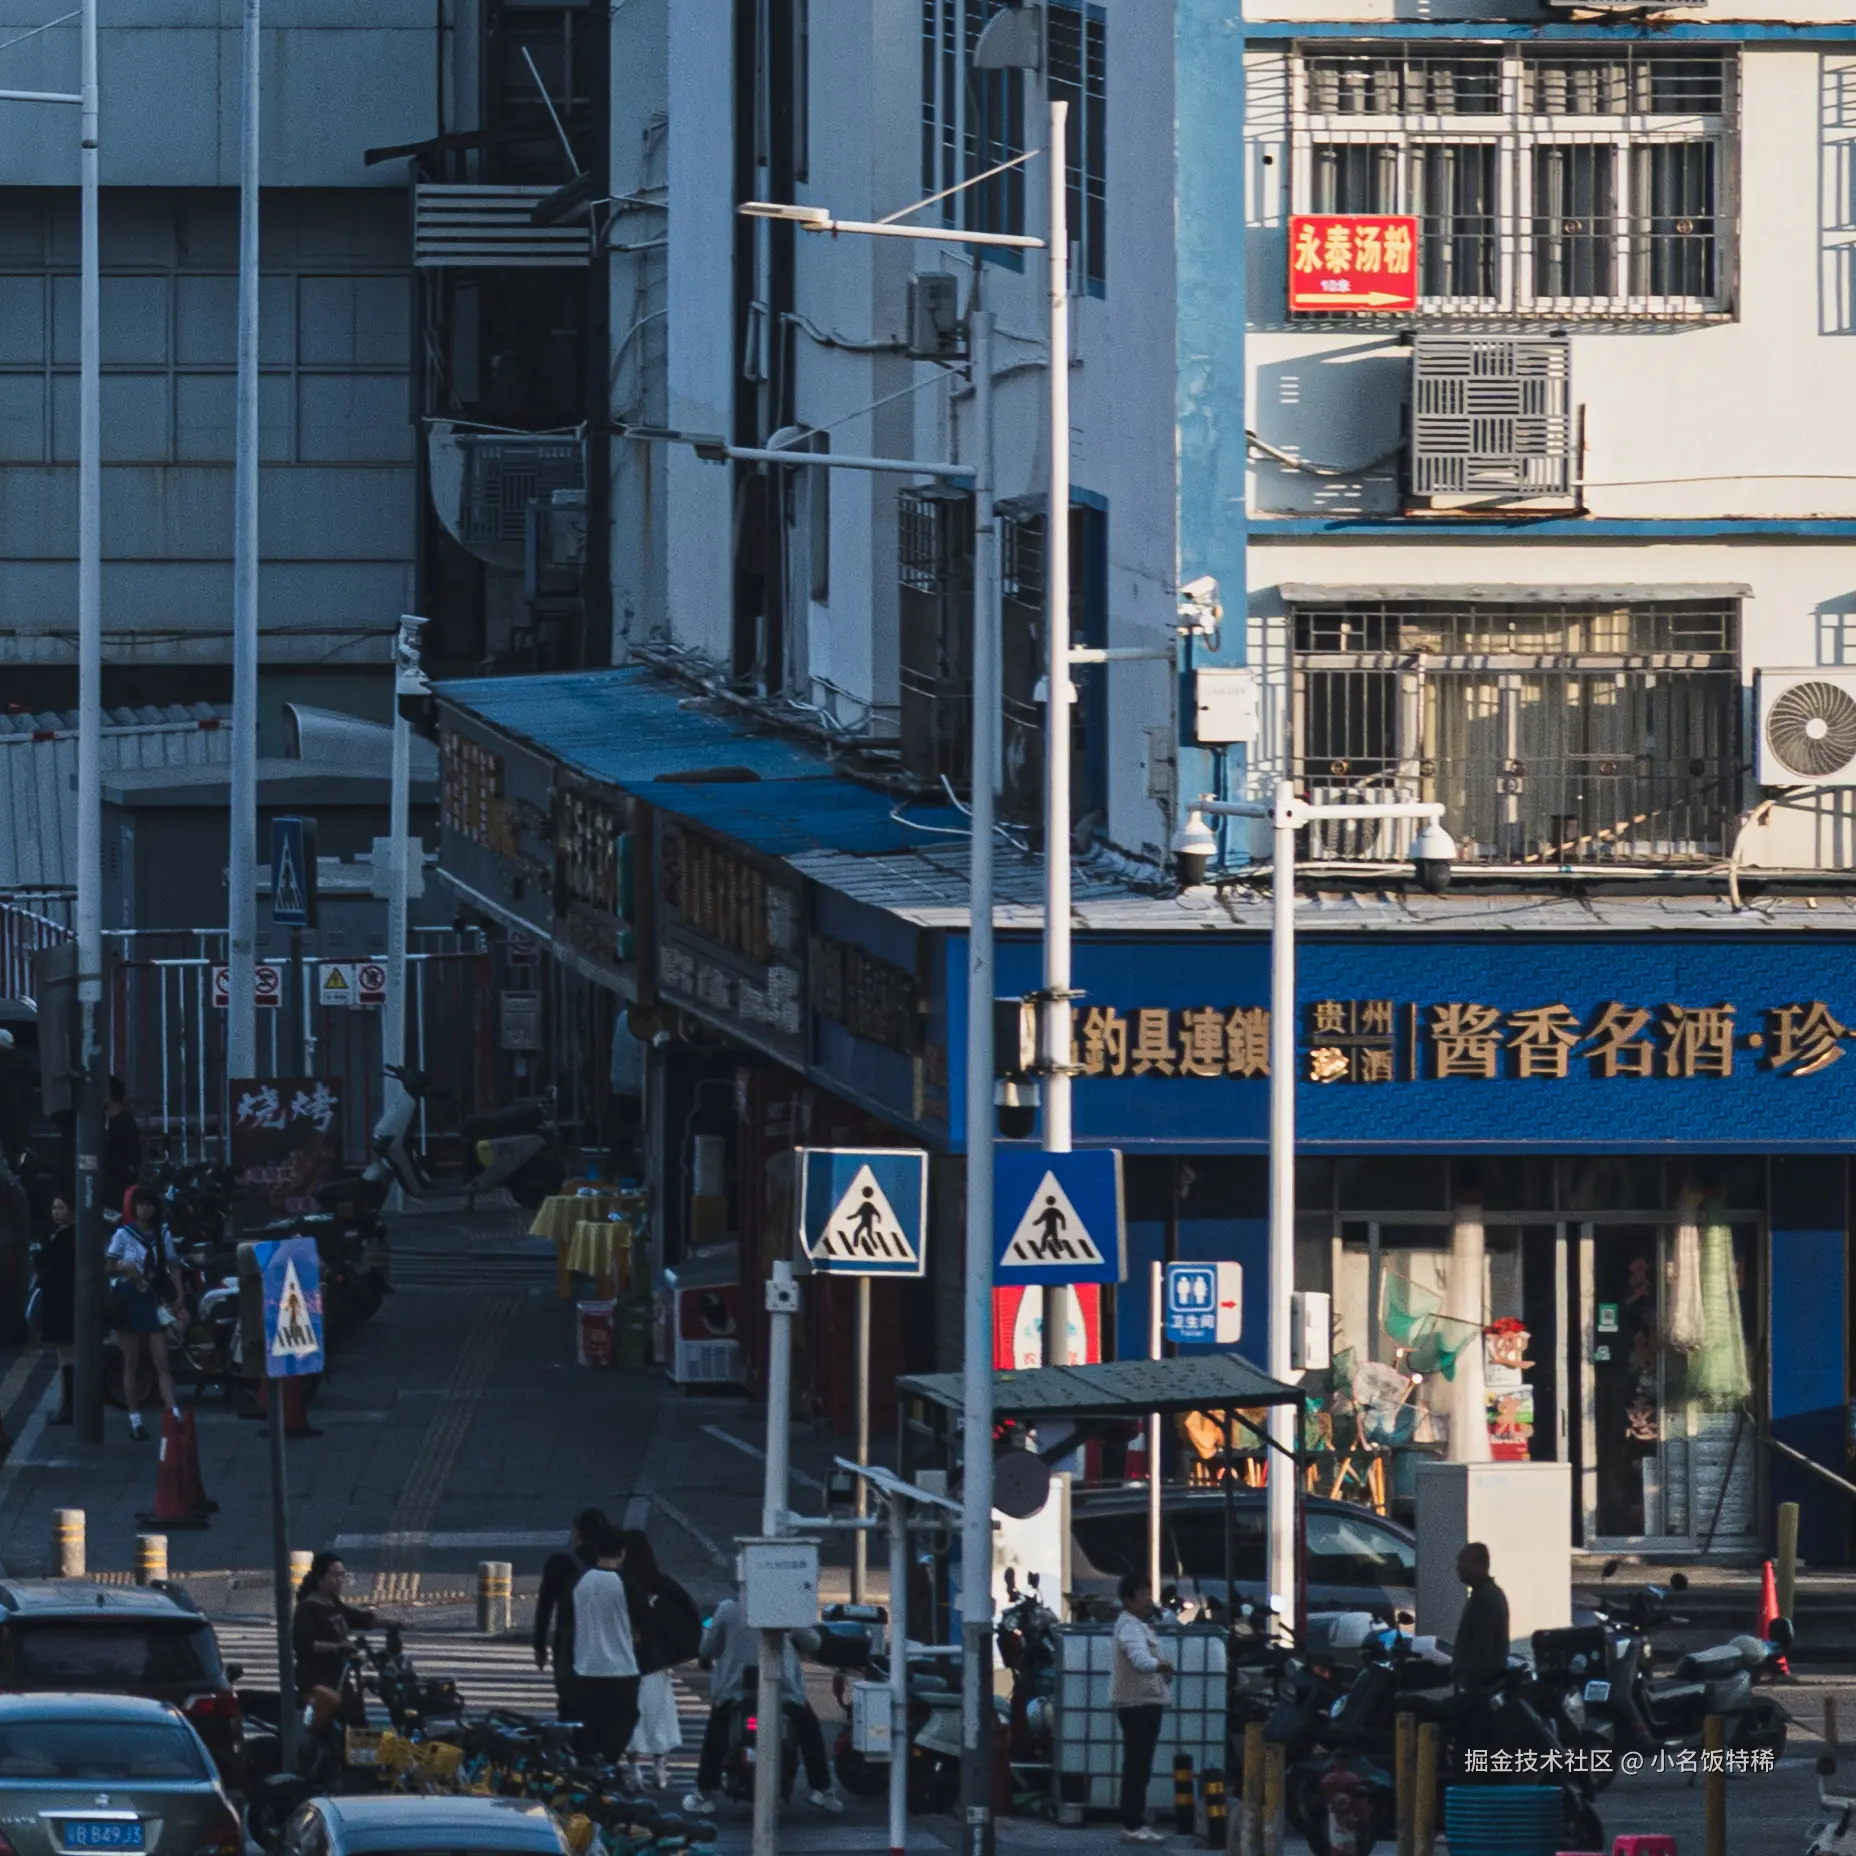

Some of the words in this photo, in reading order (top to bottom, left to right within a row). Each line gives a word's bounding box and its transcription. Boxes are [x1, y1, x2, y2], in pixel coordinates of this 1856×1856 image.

[1295, 224, 1412, 274] 永泰汤粉
[1432, 1000, 1856, 1078] 酱香名酒·珍
[235, 1081, 340, 1132] 烧烤
[1171, 1314, 1215, 1329] 卫生间
